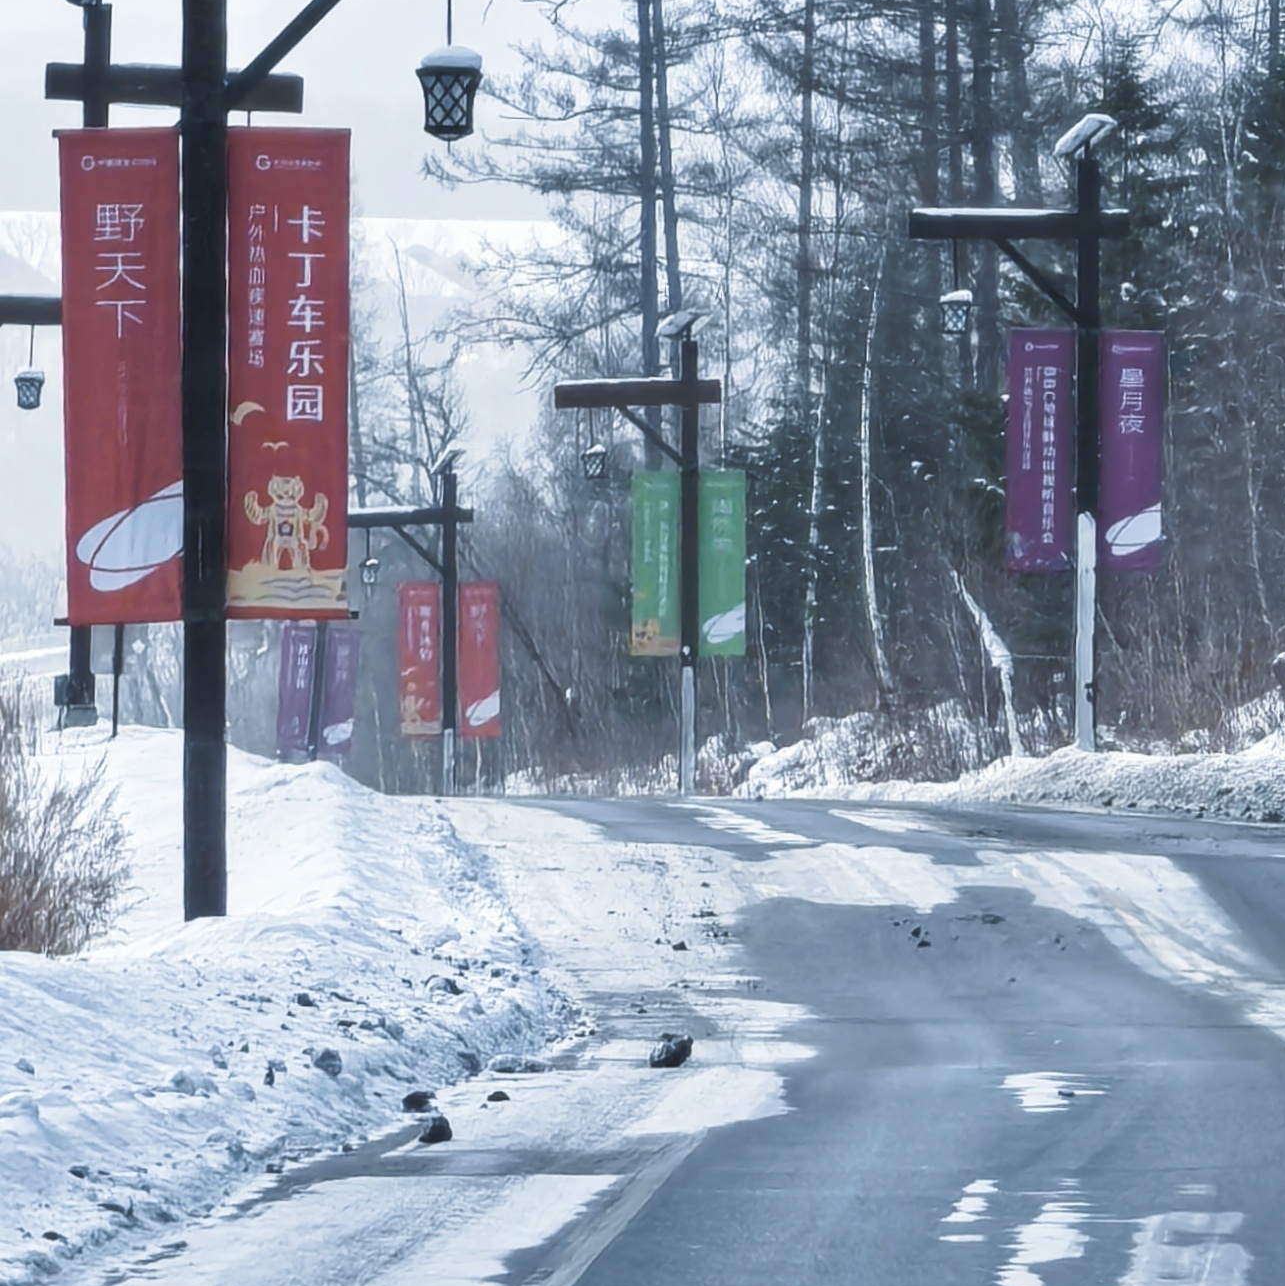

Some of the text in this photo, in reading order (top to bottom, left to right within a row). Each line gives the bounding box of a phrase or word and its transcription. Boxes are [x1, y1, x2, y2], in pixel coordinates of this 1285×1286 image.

[94, 203, 145, 340] 野天下
[286, 205, 326, 422] 卡丁车乐园
[1118, 368, 1146, 435] 星月夜
